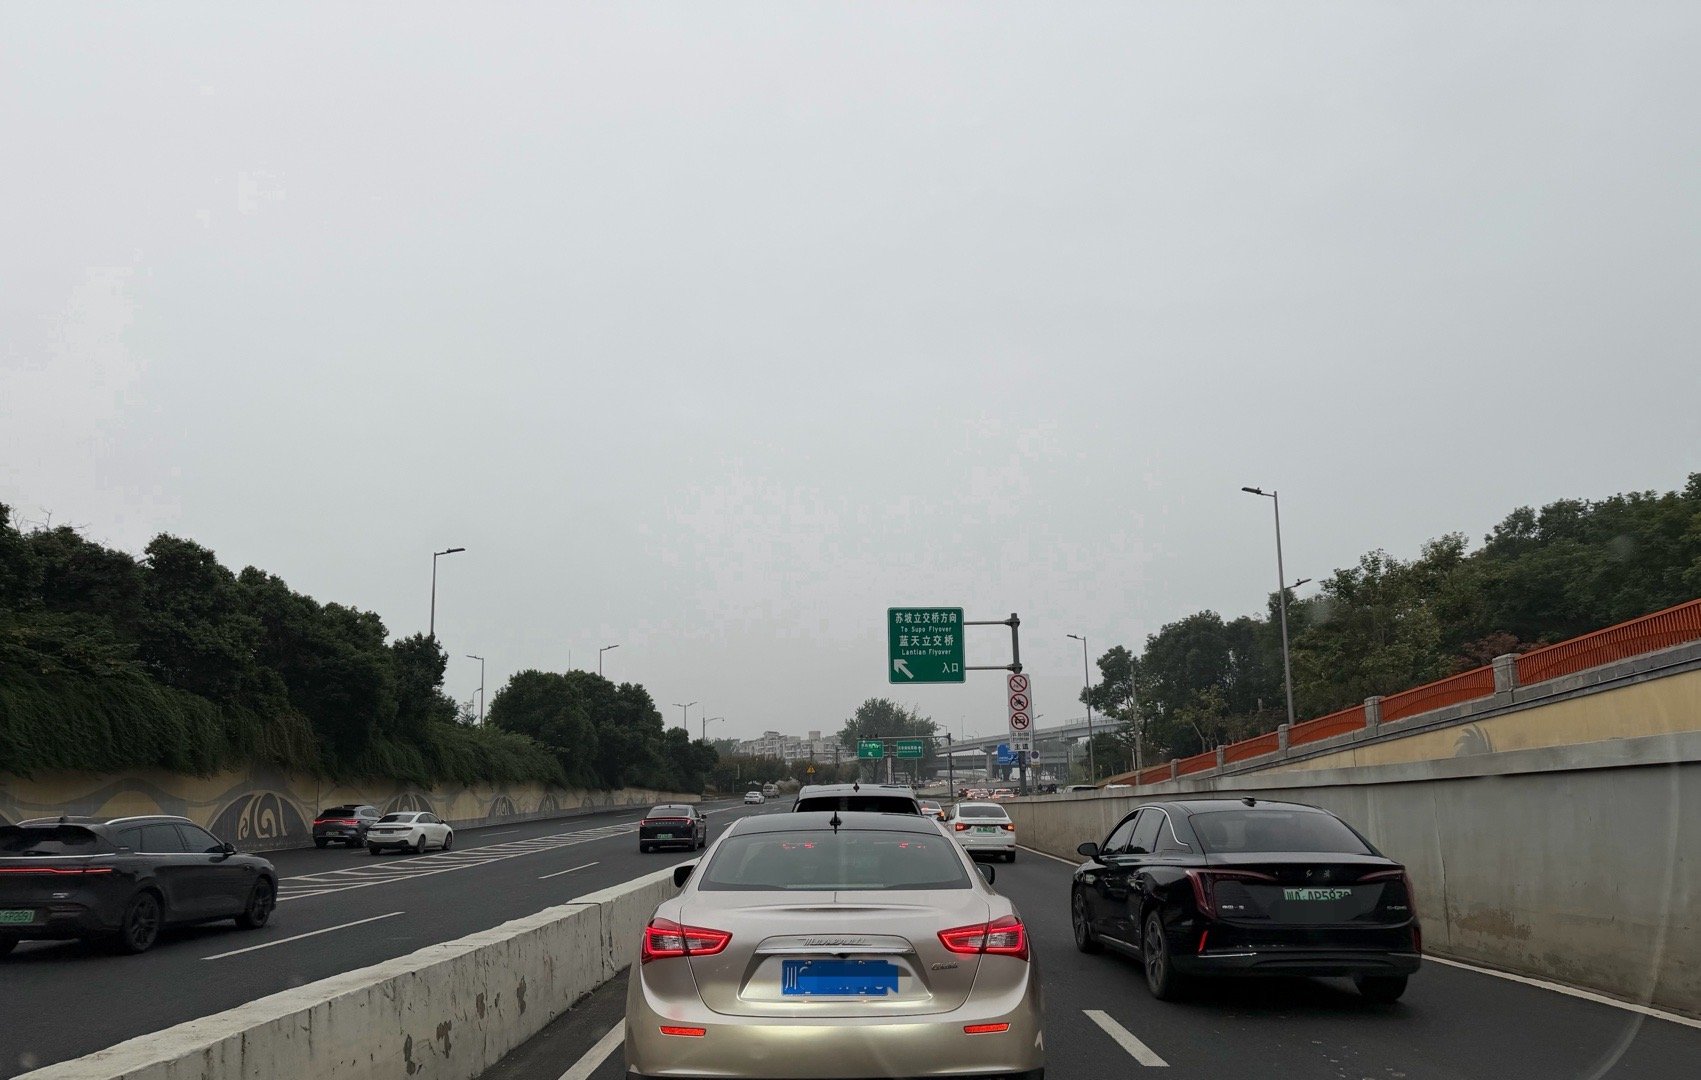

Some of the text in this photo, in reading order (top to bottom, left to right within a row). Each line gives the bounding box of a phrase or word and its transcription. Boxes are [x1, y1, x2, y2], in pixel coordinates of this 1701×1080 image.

[895, 612, 957, 624] 苏坡立交桥方向
[899, 635, 954, 646] 蓝天立交桥
[942, 662, 959, 673] 入口
